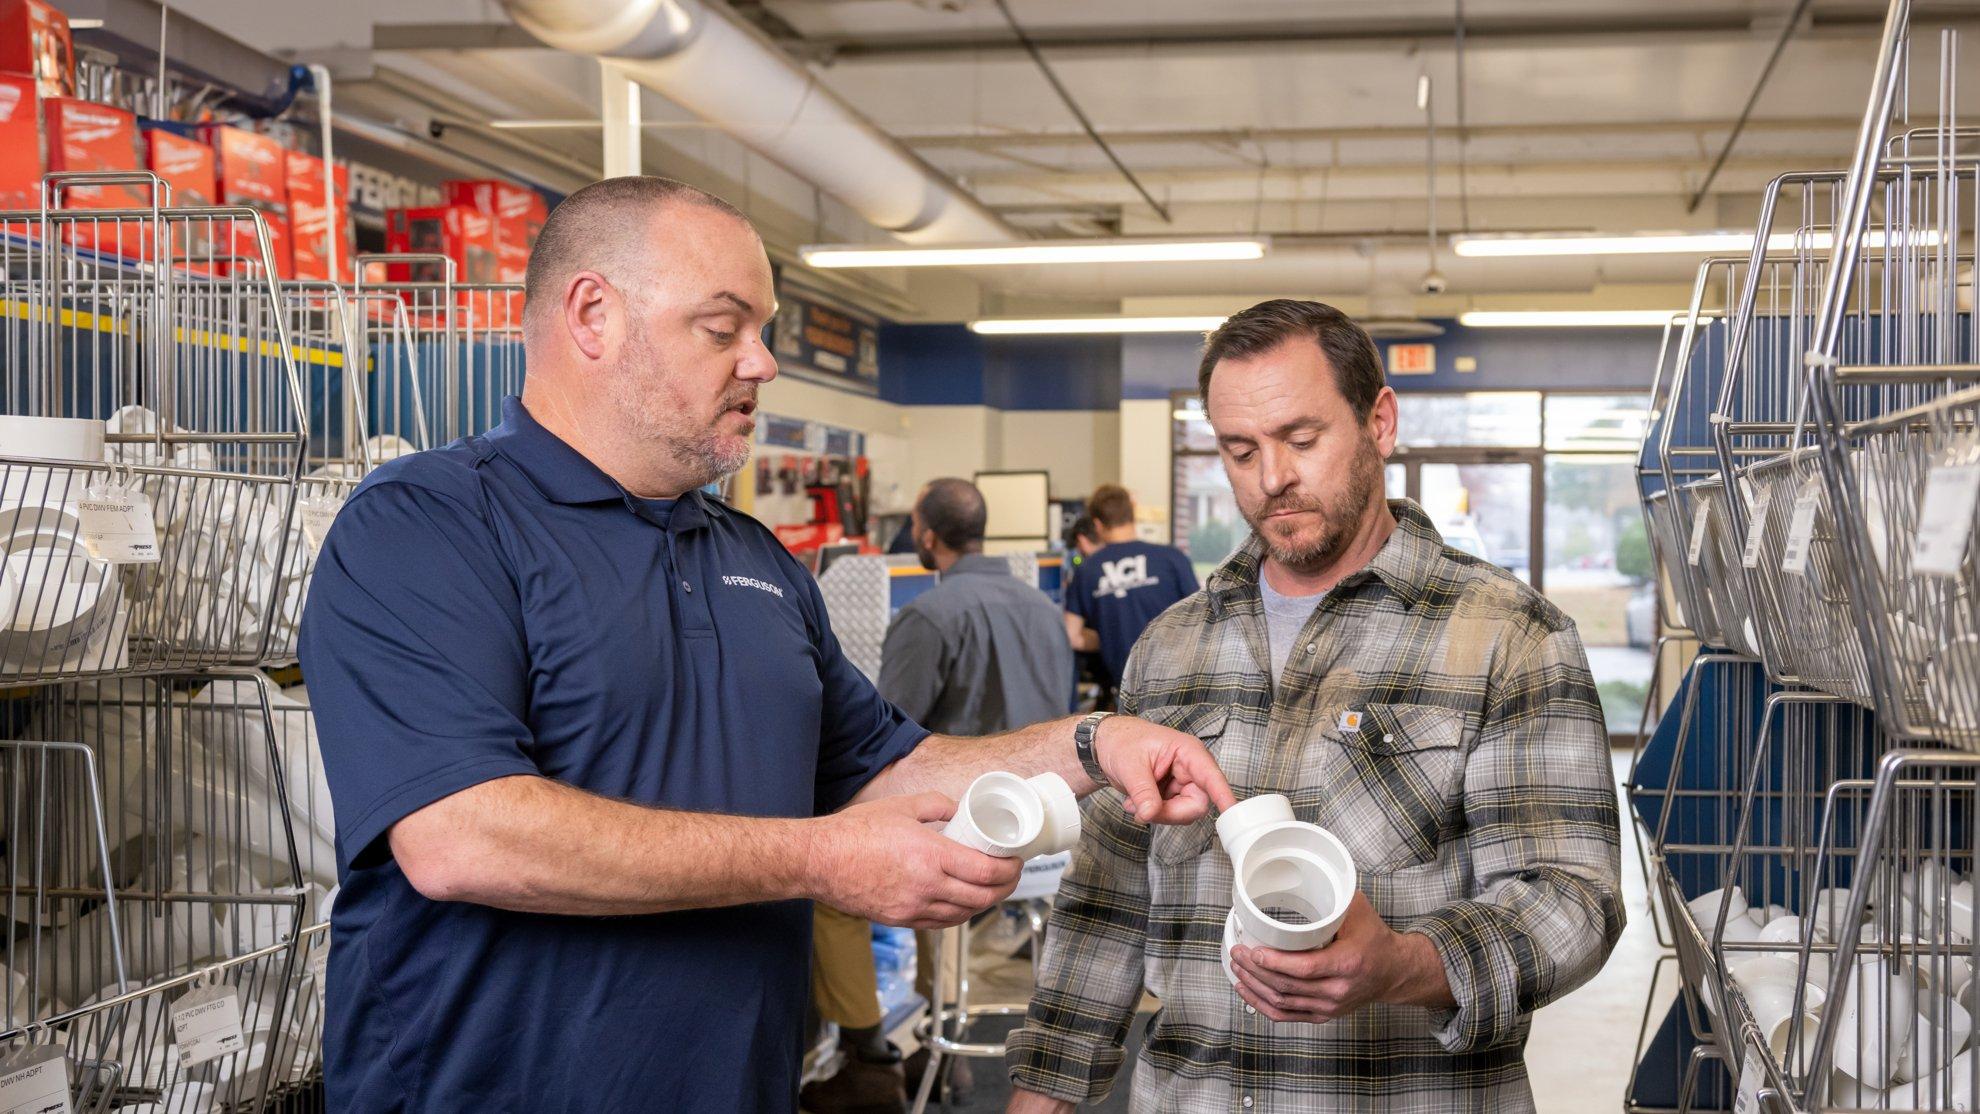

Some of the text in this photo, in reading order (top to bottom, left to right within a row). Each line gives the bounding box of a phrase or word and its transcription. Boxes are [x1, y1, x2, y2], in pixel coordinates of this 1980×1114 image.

[83, 503, 93, 511] PVC
[94, 503, 106, 511] DWV
[107, 504, 119, 512] FEM
[120, 505, 135, 513] ADPT
[730, 576, 783, 598] FERGUSON
[185, 1009, 194, 1018] PVC
[195, 1006, 206, 1016] DWV
[0, 1066, 42, 1088] DWV NH ADPT
